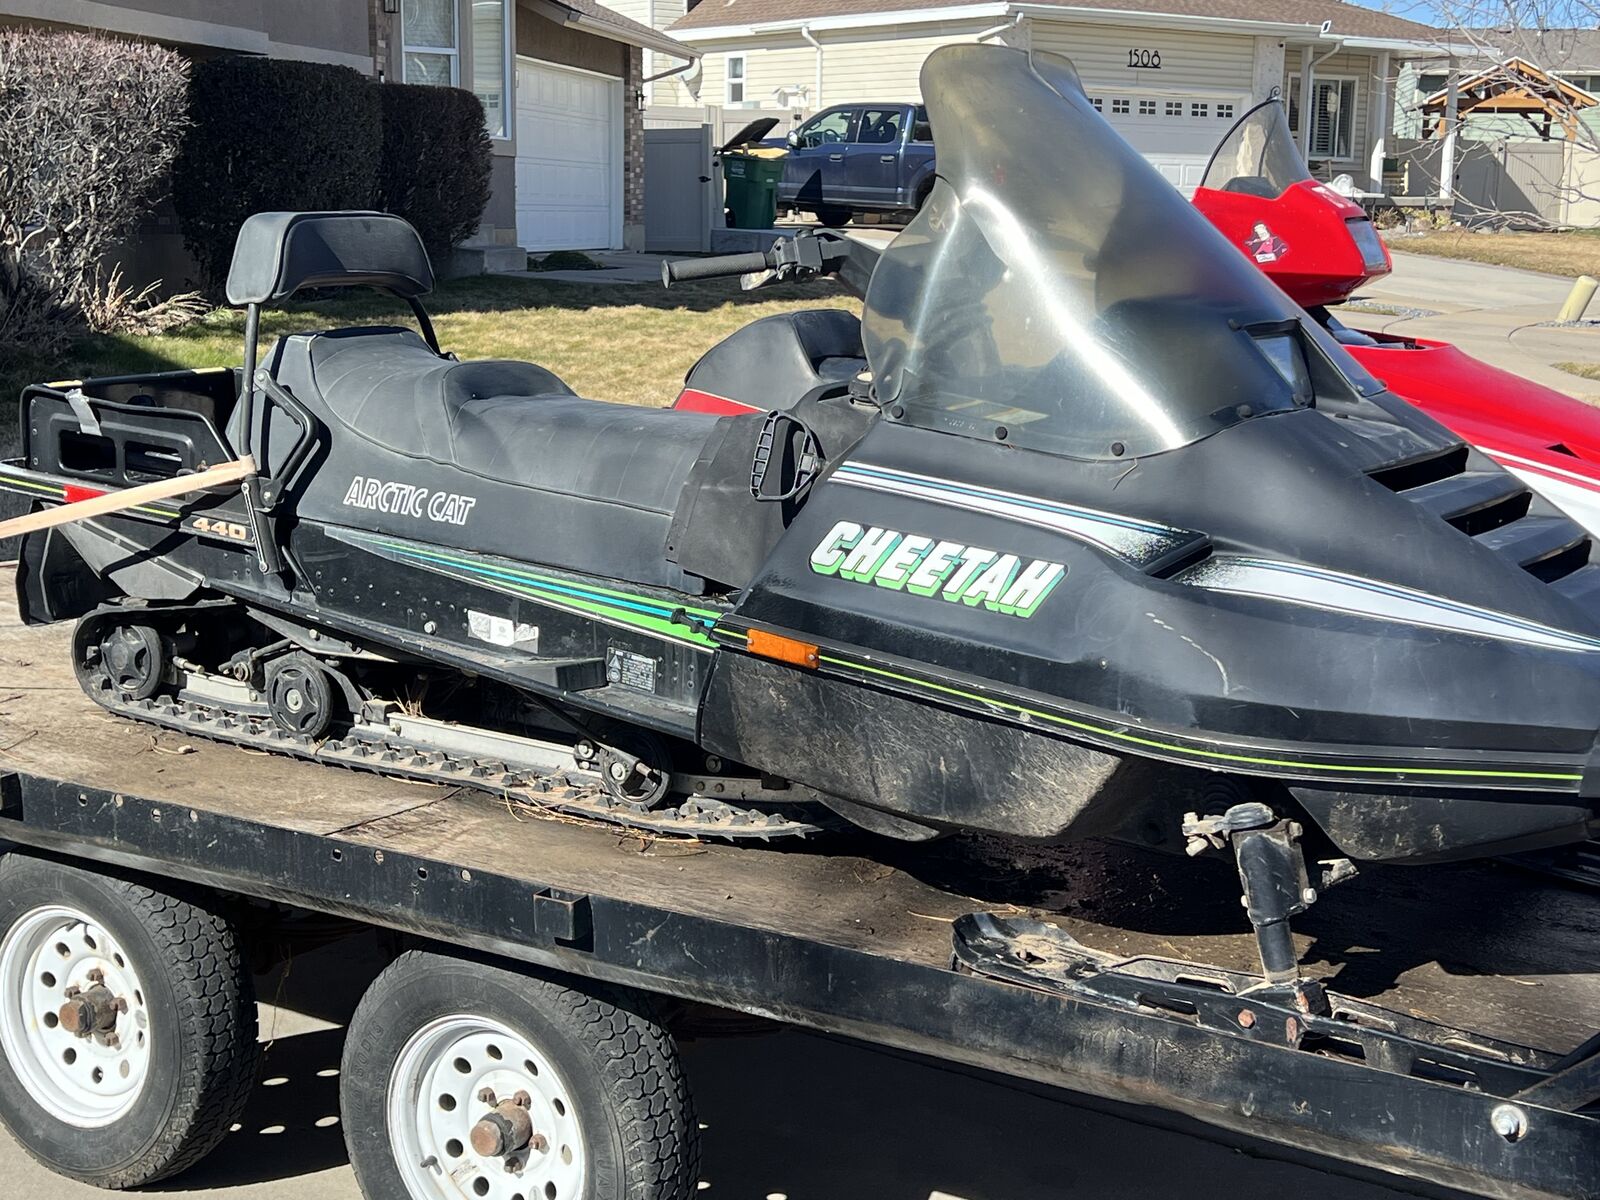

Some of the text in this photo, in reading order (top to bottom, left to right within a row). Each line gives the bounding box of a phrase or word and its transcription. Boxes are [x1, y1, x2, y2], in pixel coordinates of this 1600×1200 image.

[1128, 49, 1161, 68] 1508
[343, 476, 476, 525] ARCTIC CAT
[192, 517, 246, 540] 440
[810, 519, 1066, 618] CHEETAH
